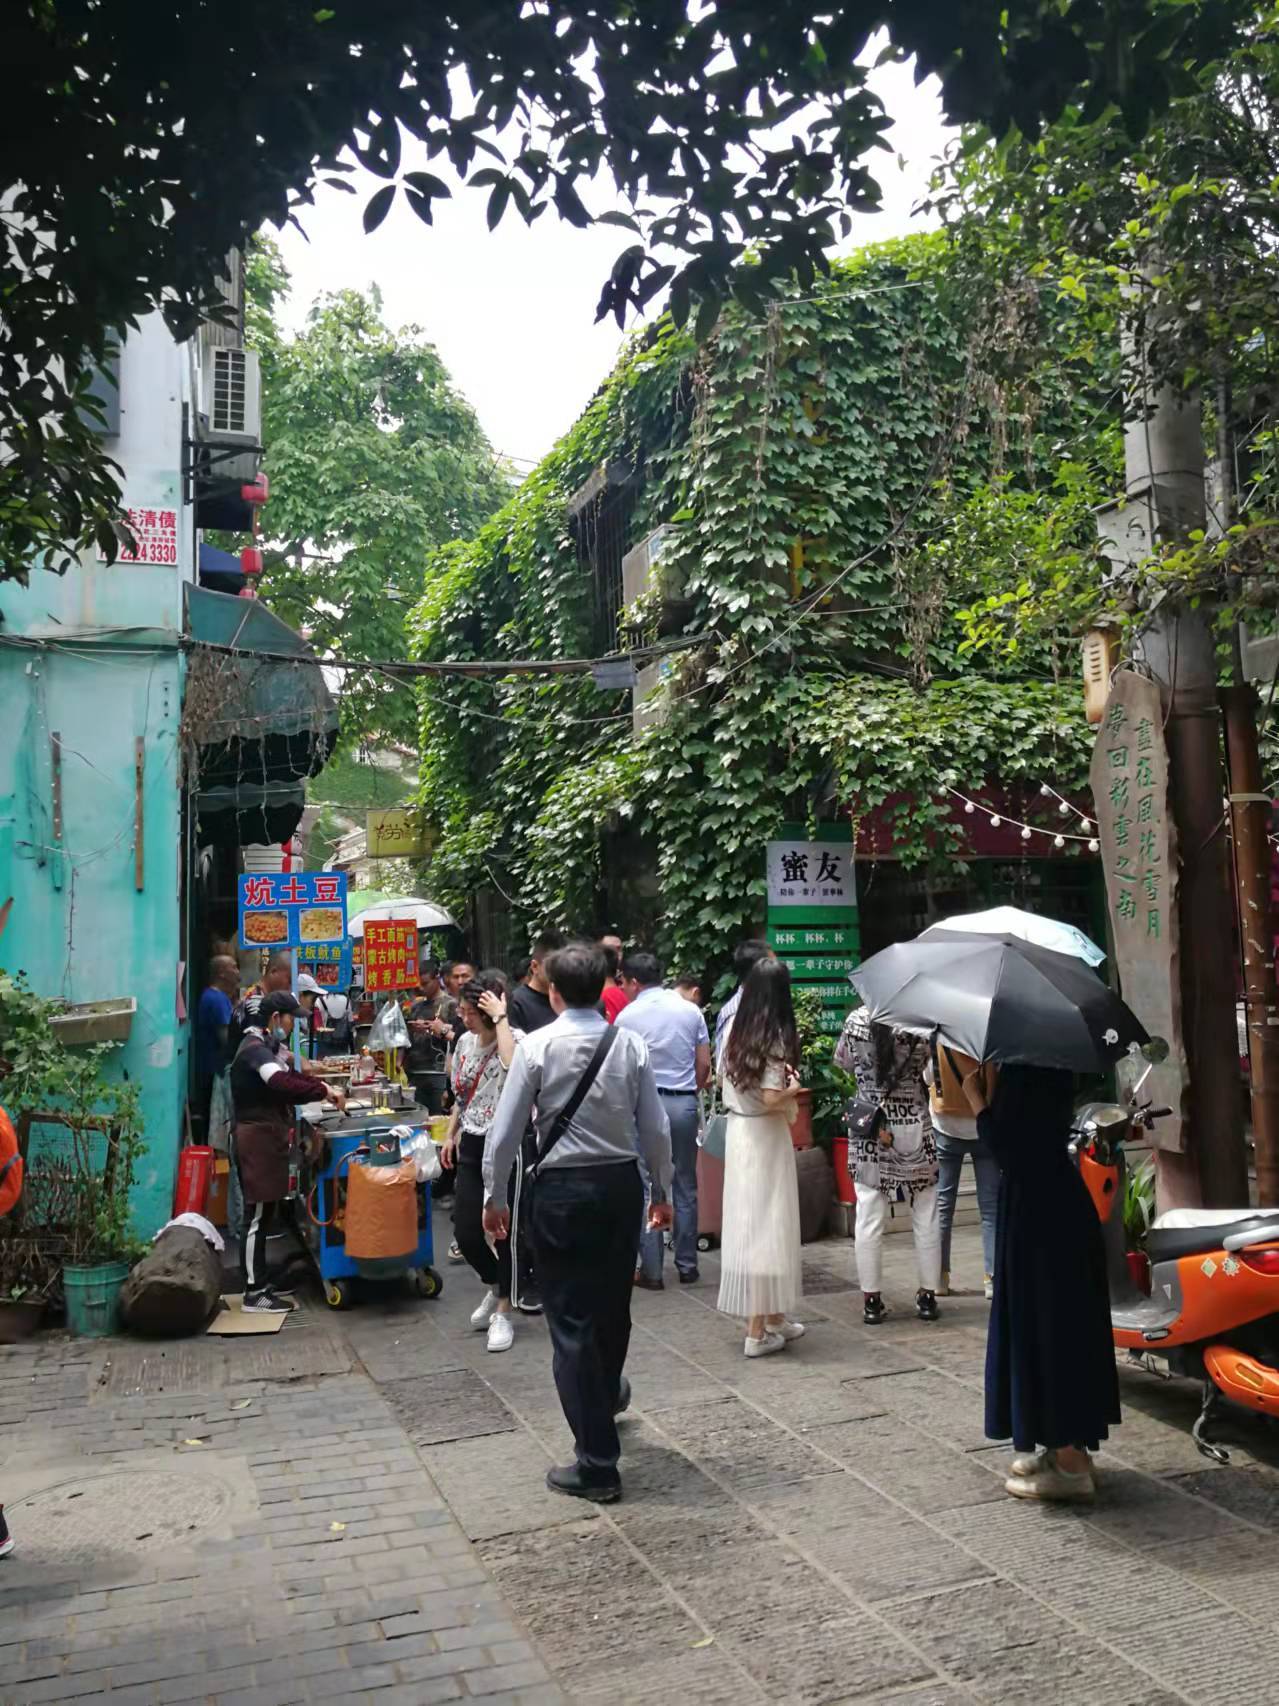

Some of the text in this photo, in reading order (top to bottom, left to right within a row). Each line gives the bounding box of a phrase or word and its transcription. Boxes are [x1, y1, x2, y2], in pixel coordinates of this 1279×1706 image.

[781, 850, 842, 884] 蜜友
[244, 876, 342, 907] 炕土豆
[366, 926, 405, 945] 手工面筋
